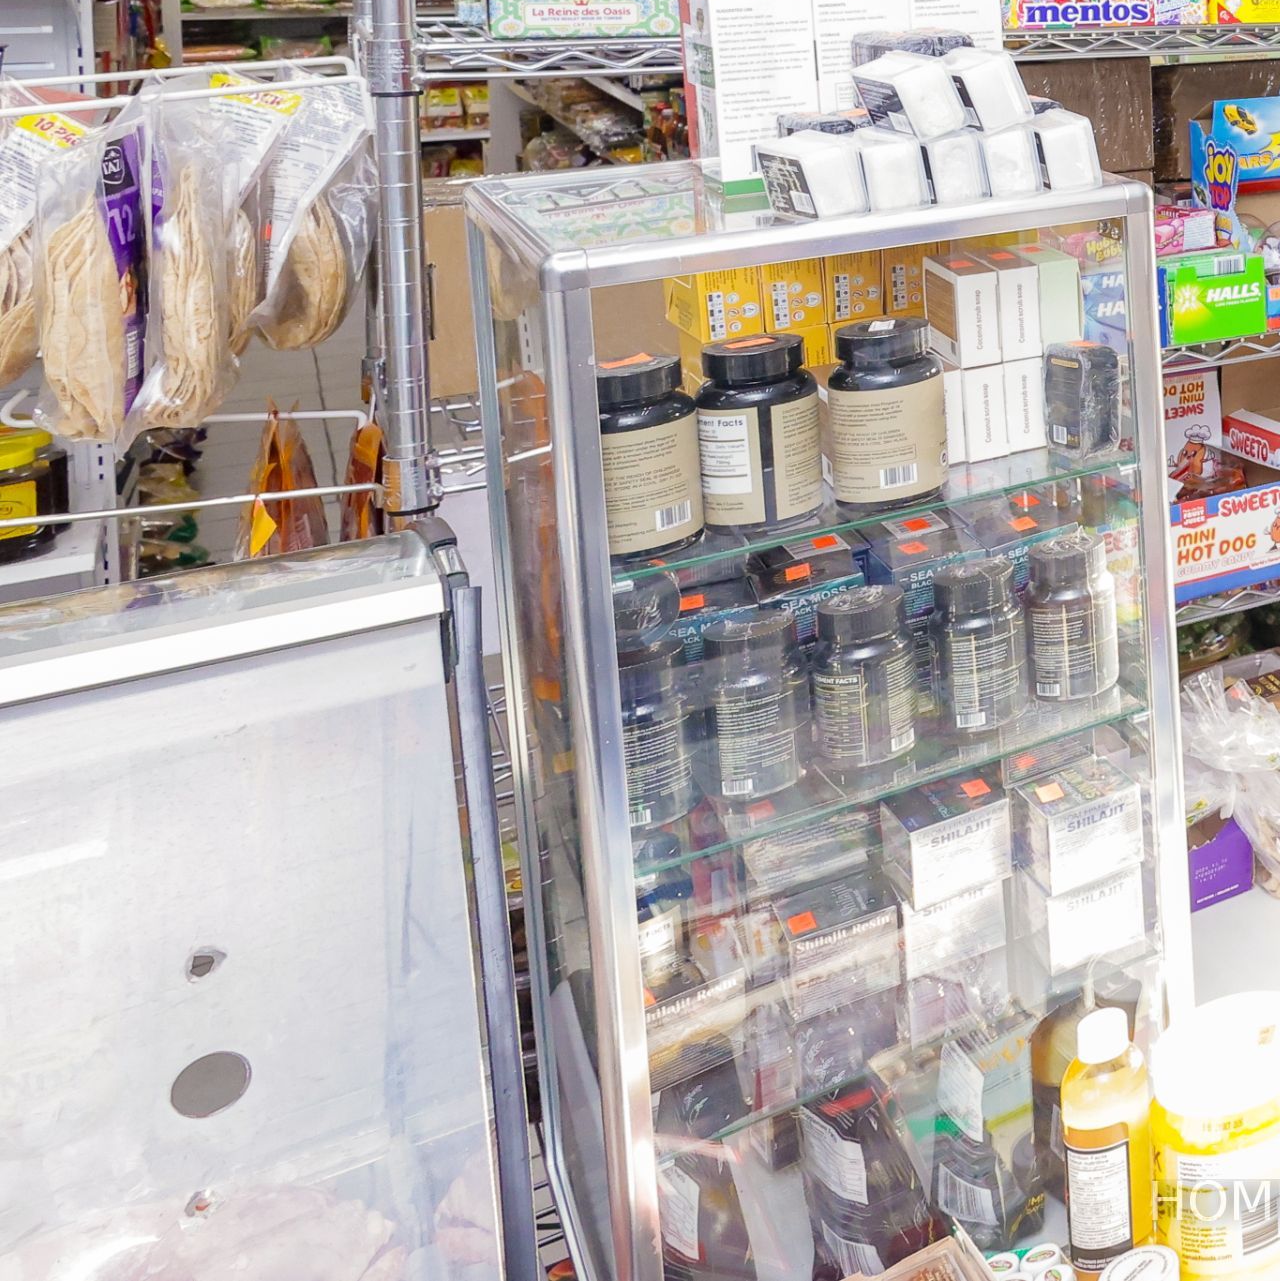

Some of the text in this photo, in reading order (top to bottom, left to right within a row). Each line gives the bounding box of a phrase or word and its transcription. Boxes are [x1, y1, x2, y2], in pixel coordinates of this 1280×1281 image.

[532, 8, 631, 17] La Reine des Oasis
[1026, 0, 1149, 23] mentos
[1206, 148, 1235, 185] JOY
[1209, 185, 1231, 210] TOP
[1207, 282, 1261, 303] HALLS
[1179, 393, 1204, 404] MINI
[1181, 381, 1204, 392] HOT
[1230, 428, 1269, 461] SWEETO
[1177, 528, 1216, 549] MINI
[1177, 533, 1257, 566] HOT DOG
[781, 584, 847, 612] SEA MOSS
[1067, 803, 1127, 834] SHILAJIT
[931, 819, 992, 848] SHILAJIT
[796, 915, 891, 954] Shilajit Resin
[695, 975, 738, 1003] Resin
